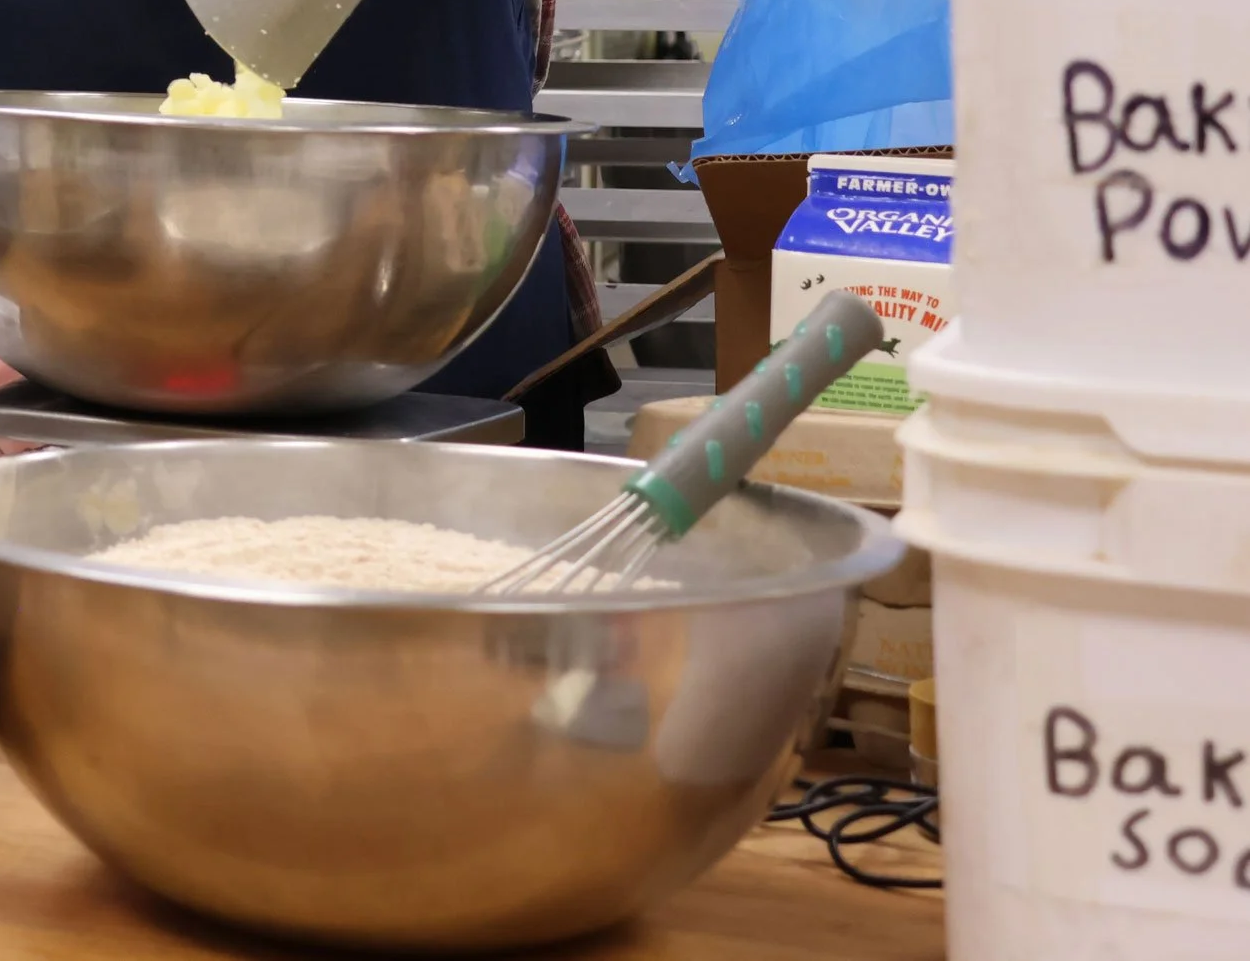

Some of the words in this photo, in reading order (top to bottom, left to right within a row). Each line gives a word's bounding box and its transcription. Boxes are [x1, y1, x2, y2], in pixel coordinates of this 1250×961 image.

[835, 219, 954, 242] VALLEY
[878, 285, 897, 298] THE
[901, 289, 923, 303] WAY
[927, 295, 939, 309] TO
[867, 300, 917, 321] ALITY
[1044, 706, 1244, 809] Bak
